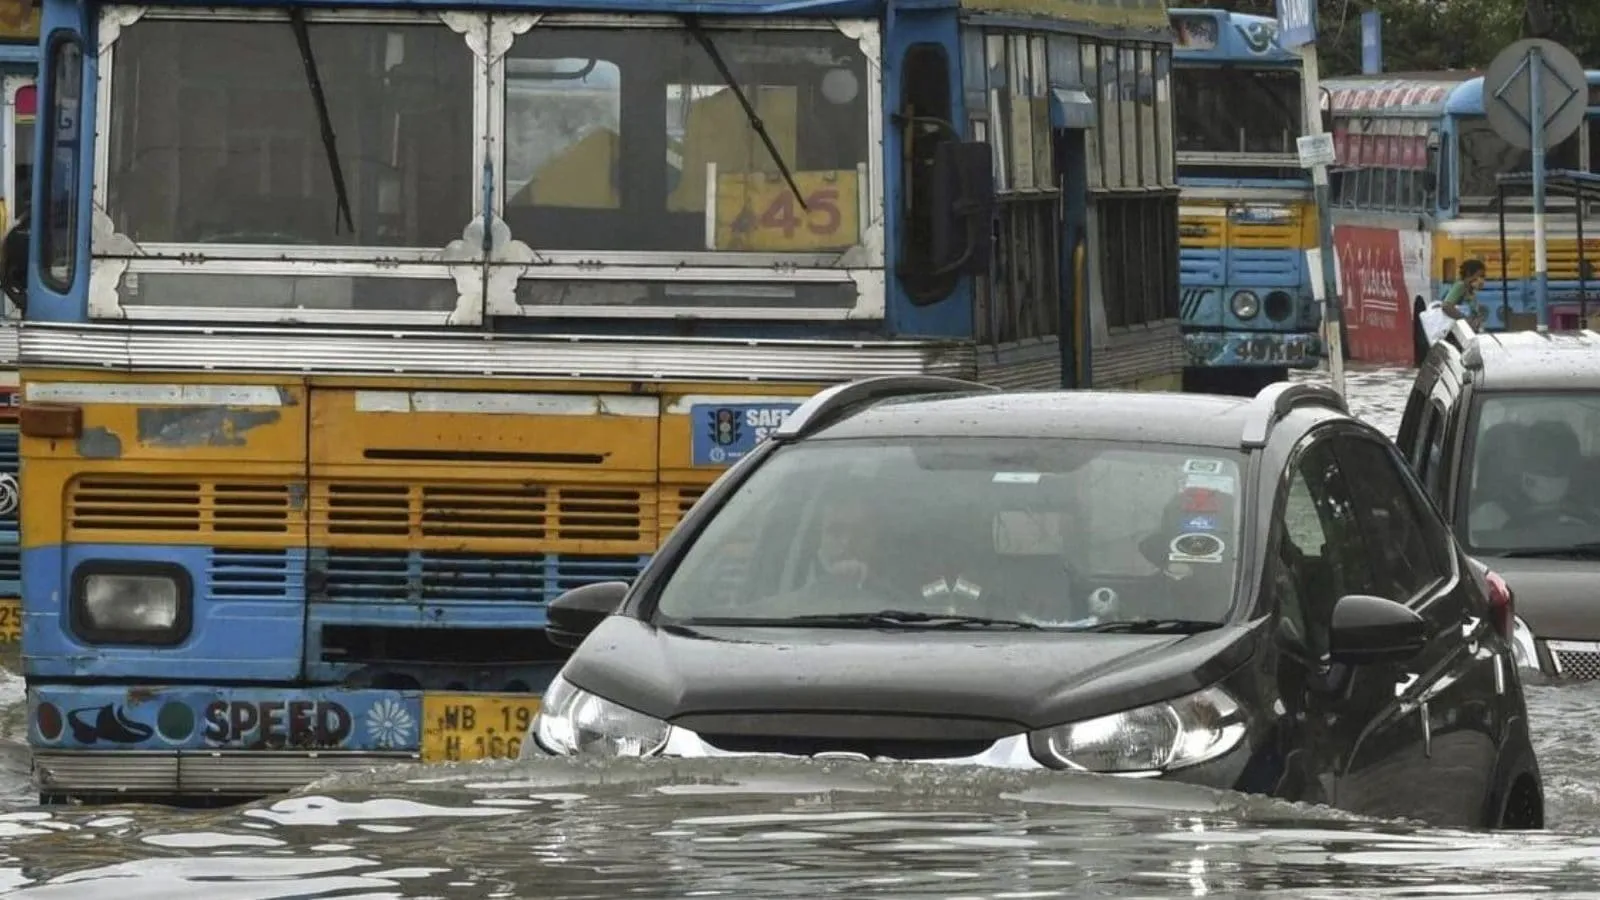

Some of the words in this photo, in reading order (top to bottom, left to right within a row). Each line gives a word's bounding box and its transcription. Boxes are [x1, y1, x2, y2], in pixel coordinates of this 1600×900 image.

[760, 188, 841, 239] 45
[204, 699, 354, 749] SPEED
[444, 704, 476, 731] WB
[501, 705, 530, 732] 19
